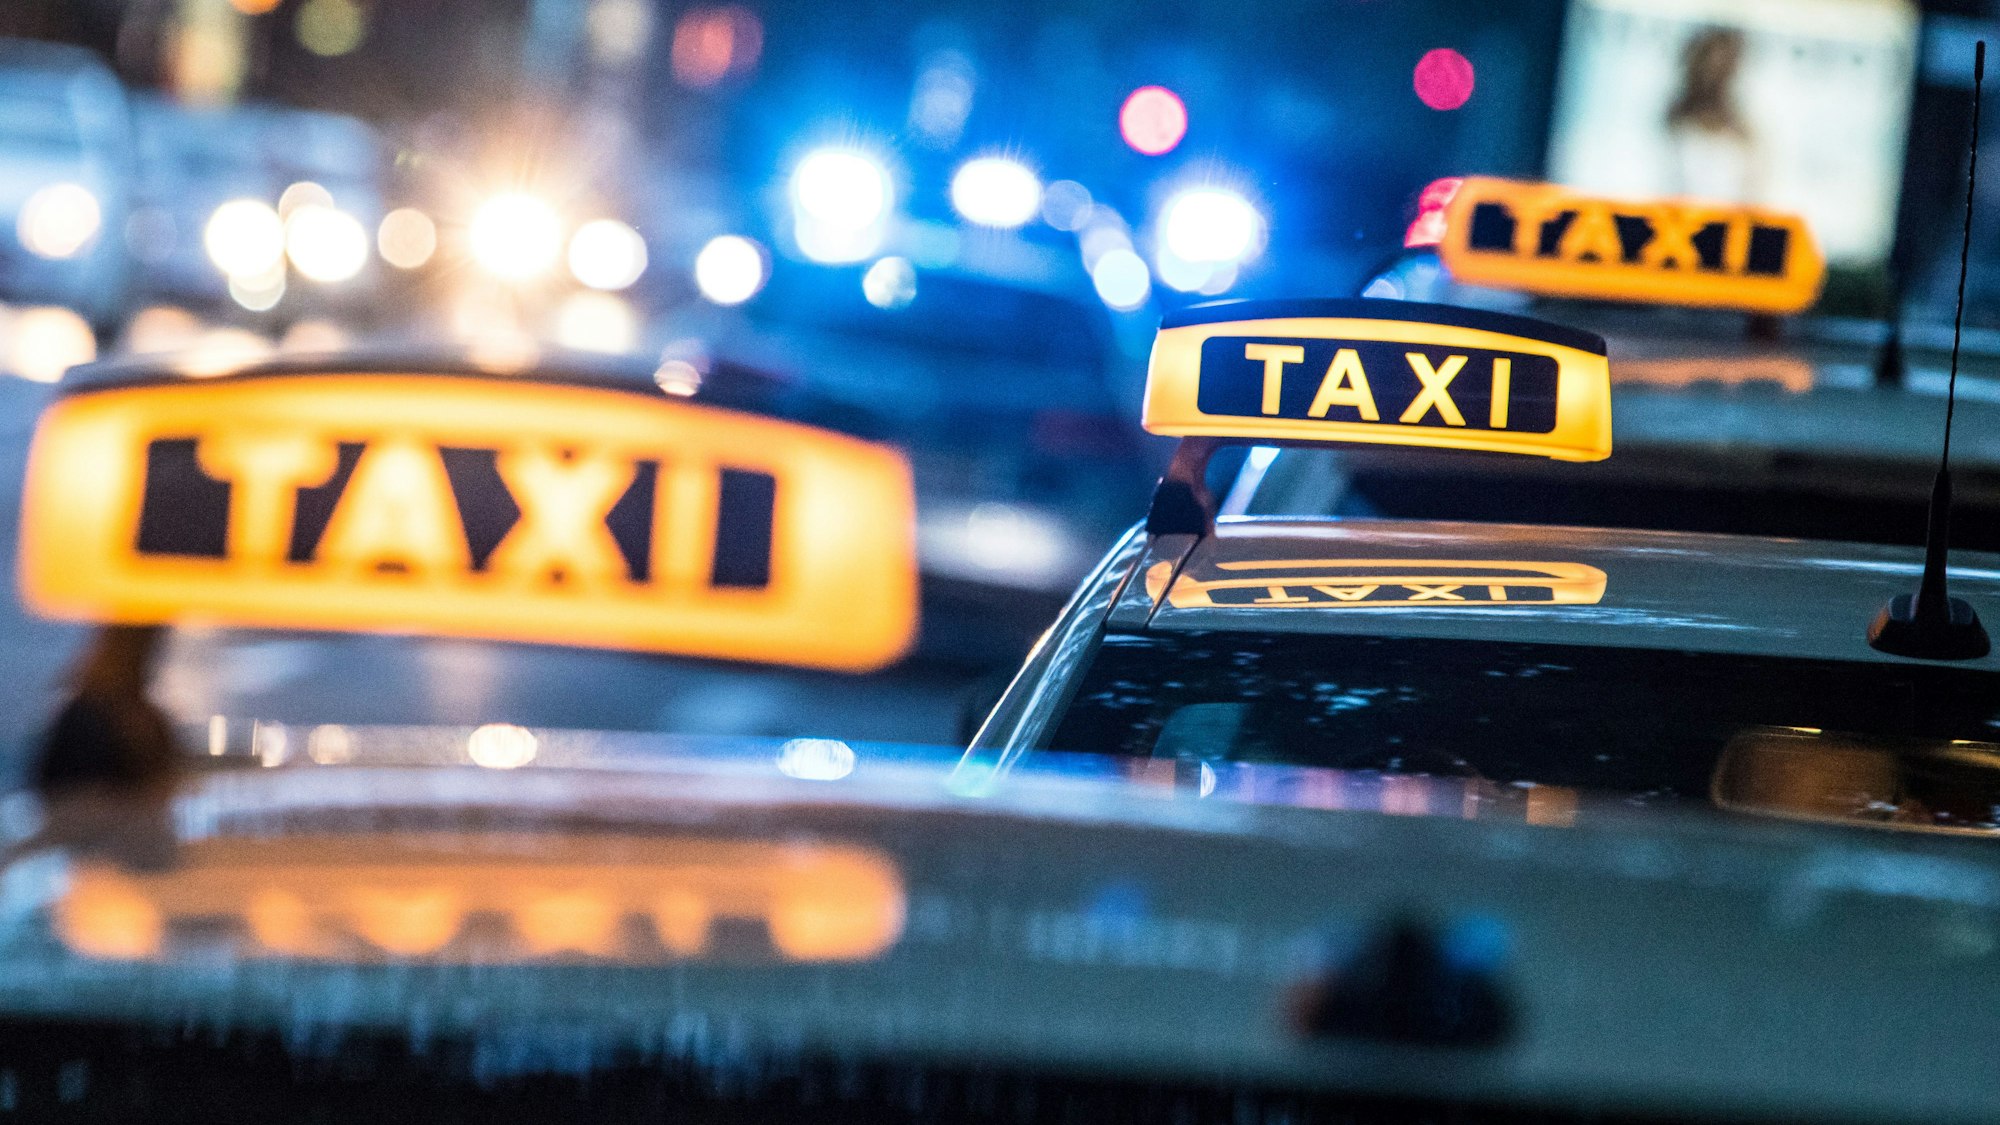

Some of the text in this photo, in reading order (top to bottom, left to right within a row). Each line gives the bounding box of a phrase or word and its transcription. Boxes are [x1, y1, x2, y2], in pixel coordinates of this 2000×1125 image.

[1504, 203, 1751, 273] TAXI
[1244, 342, 1512, 429] TAXI
[198, 436, 720, 588] TAXI
